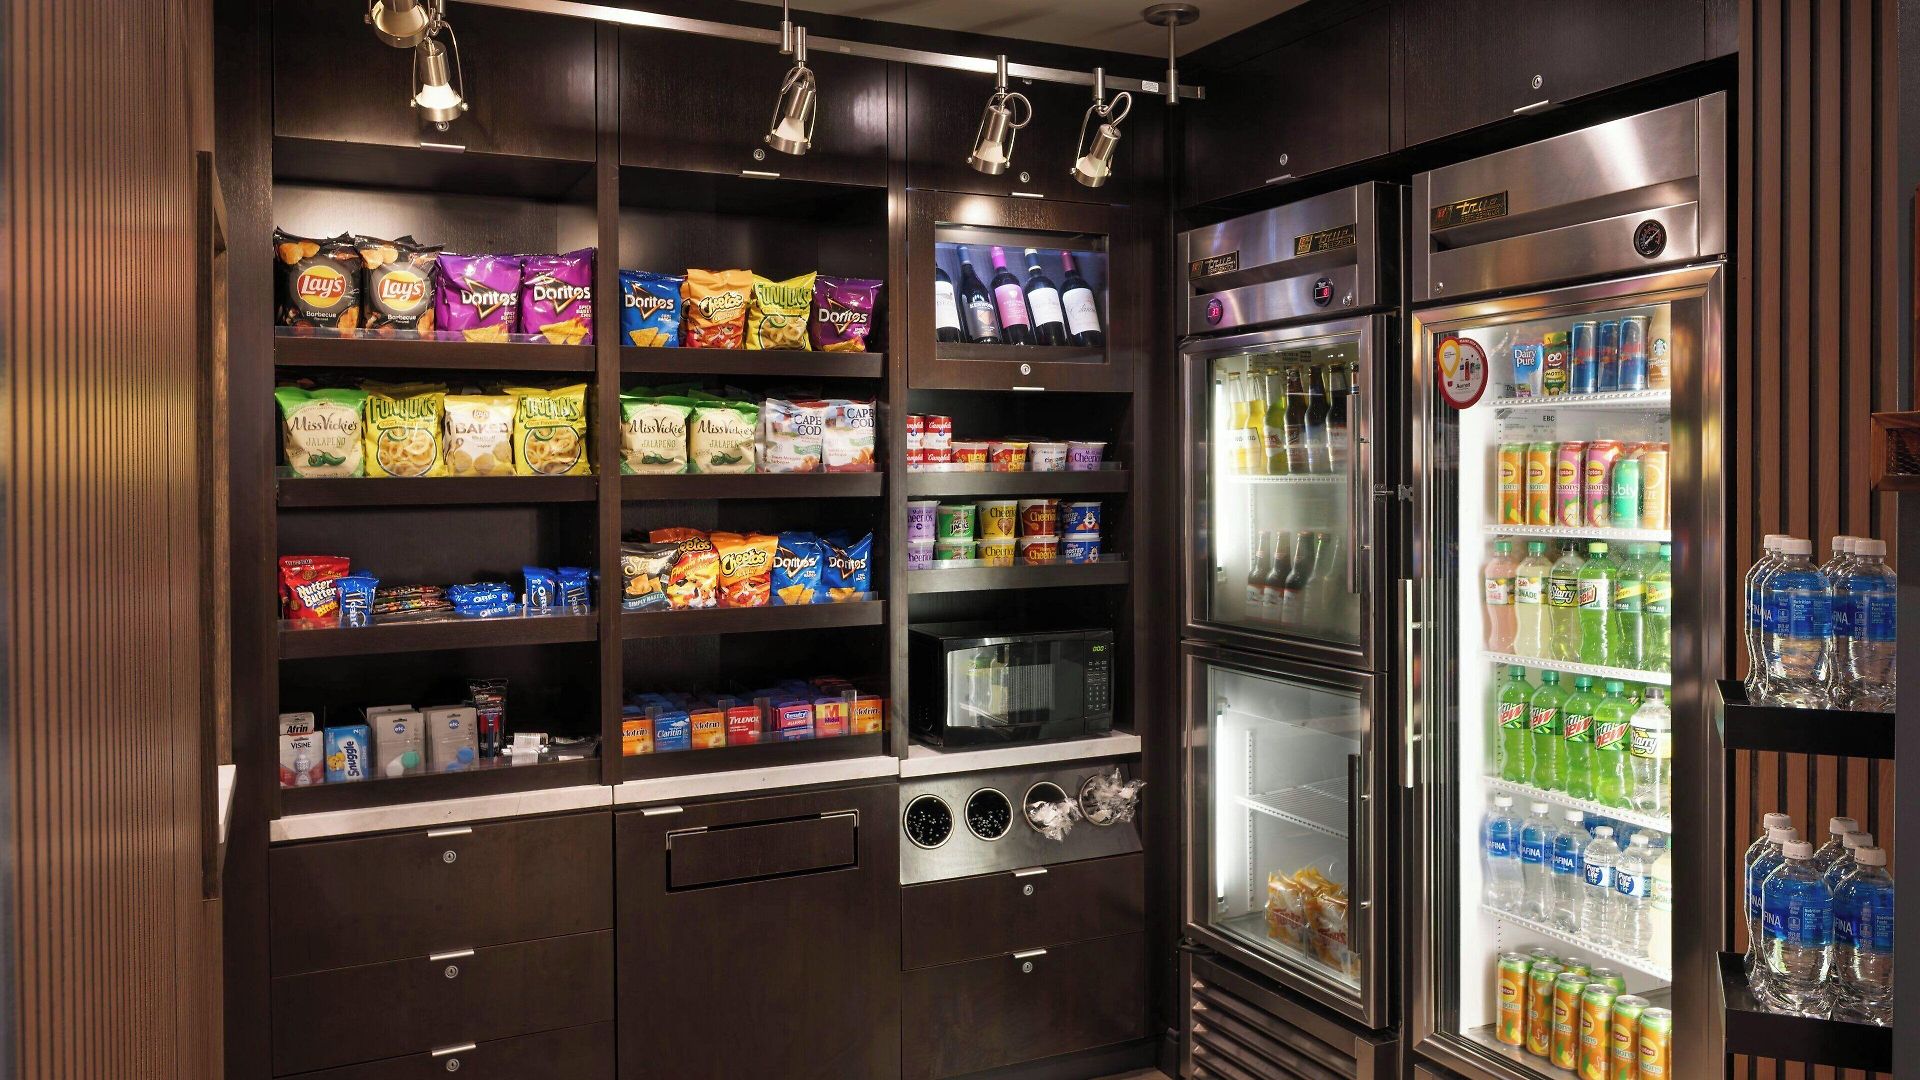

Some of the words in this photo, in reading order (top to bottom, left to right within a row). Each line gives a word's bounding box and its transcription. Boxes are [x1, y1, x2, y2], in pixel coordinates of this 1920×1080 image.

[301, 275, 342, 298] Lay's
[382, 279, 422, 301] Lay's
[534, 286, 591, 302] Doritos
[461, 290, 518, 306] Doritos
[625, 294, 674, 310] Doritos
[699, 292, 743, 319] Cheetos
[819, 308, 869, 323] Doritos
[1515, 349, 1537, 359] Dairy
[794, 414, 822, 426] CAPE
[847, 407, 874, 419] CAPE
[797, 424, 822, 436] COD
[851, 418, 875, 429] COD
[721, 548, 767, 578] Cheetos
[773, 557, 816, 568] Doritos
[829, 556, 867, 570] Doritos
[297, 580, 333, 598] Nutter
[304, 588, 337, 607] Butter
[538, 586, 548, 615] OREO
[729, 715, 760, 724] TYLENOL
[287, 725, 308, 734] Afrin
[291, 741, 311, 750] VISINE
[343, 740, 360, 777] Snuggle
